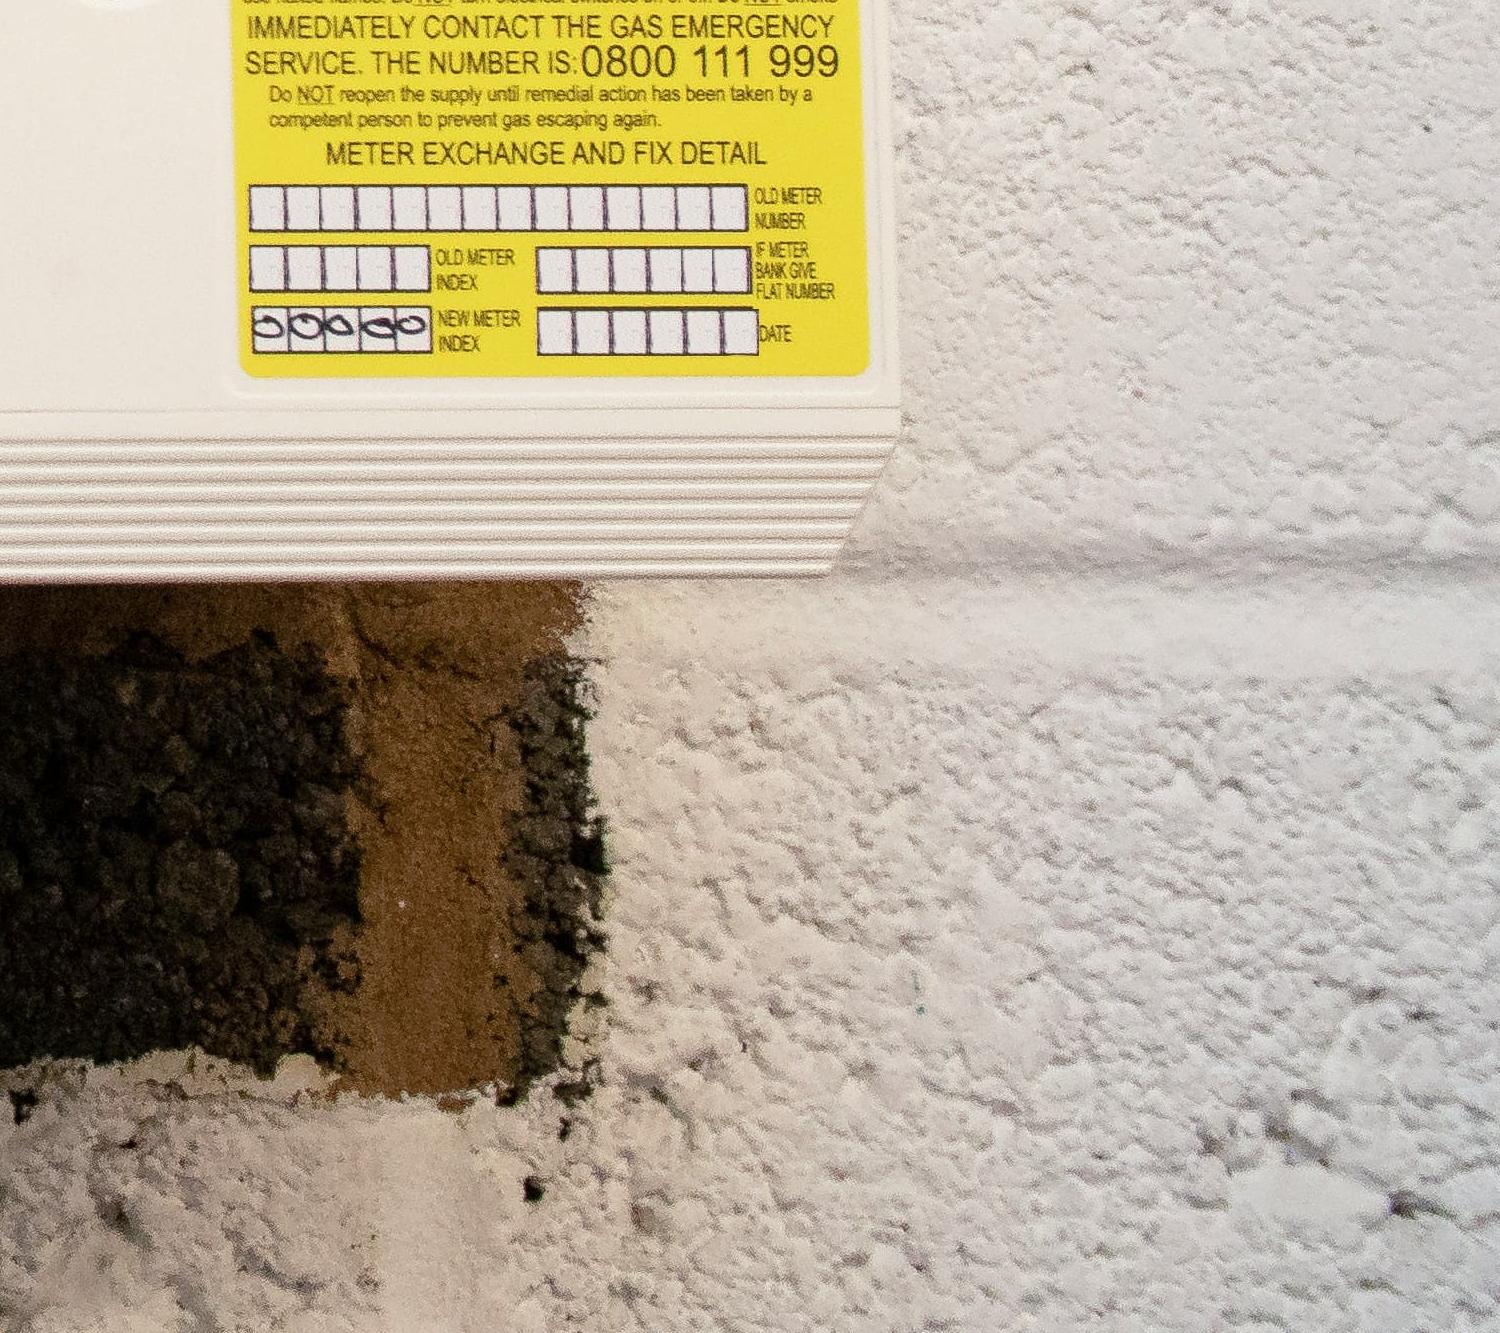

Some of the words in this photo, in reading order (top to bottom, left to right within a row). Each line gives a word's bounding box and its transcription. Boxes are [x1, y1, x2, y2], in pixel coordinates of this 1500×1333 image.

[248, 14, 415, 39] IMMEDIATELY
[423, 14, 545, 39] CONTACT
[552, 14, 603, 39] THE
[610, 14, 663, 39] GAS
[671, 14, 835, 39] EMERGENCY
[245, 50, 363, 75] SERVICE.
[371, 50, 421, 75] THE
[429, 50, 541, 75] NUMBER
[693, 44, 750, 78] 111
[769, 44, 839, 78] 999
[298, 85, 334, 103] NOT
[340, 89, 395, 106] reopen
[401, 85, 425, 103] the
[430, 85, 482, 106] supply
[487, 85, 520, 103] until
[525, 85, 593, 103] remedial
[599, 85, 647, 103] action
[651, 85, 680, 103] has
[686, 85, 725, 103] been
[731, 85, 774, 103] taken
[269, 111, 353, 131] competent
[358, 115, 412, 131] person
[438, 111, 498, 131] prevent
[502, 115, 531, 131] gas
[536, 111, 607, 131] escaping
[612, 111, 662, 131] again.
[326, 141, 415, 166] METER
[423, 141, 565, 165] EXCHANGE
[572, 141, 625, 165] AND
[634, 141, 673, 165] FIX
[681, 141, 768, 165] DETAIL
[755, 188, 778, 205] OLD
[781, 188, 822, 205] METER
[755, 213, 806, 230] NUMBER
[436, 248, 463, 266] OLD
[467, 248, 516, 266] METER
[769, 241, 809, 258] METER
[755, 262, 788, 279] BANK
[790, 262, 816, 279] GIVE
[437, 274, 479, 291] INDEX
[756, 283, 783, 300] FLAT
[785, 283, 836, 300] NUMBER
[438, 310, 470, 327] NEW
[474, 310, 521, 327] METER
[759, 325, 792, 342] DATE
[438, 335, 481, 352] INDEX
